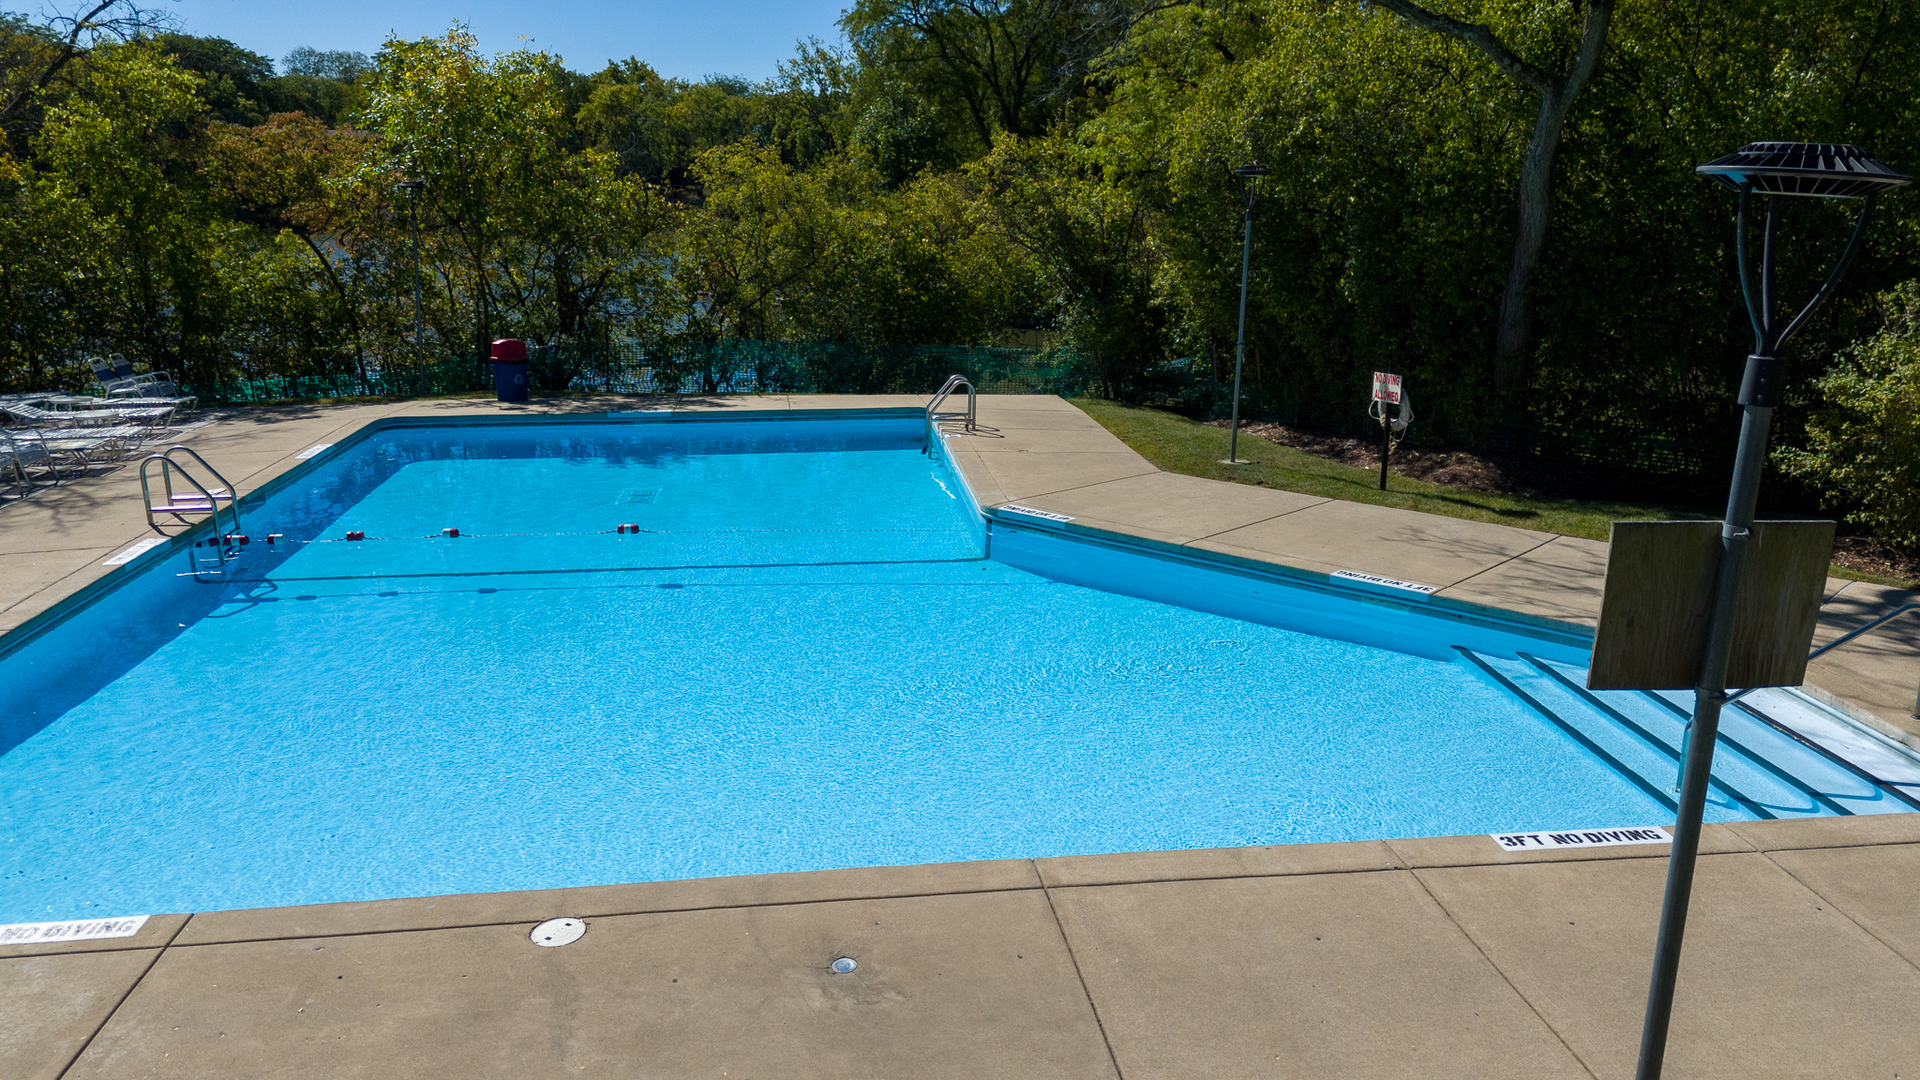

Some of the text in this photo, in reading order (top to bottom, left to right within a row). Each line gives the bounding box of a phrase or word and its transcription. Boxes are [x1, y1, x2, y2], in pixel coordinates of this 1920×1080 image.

[1375, 373, 1400, 386] NO DIVING
[1374, 389, 1398, 402] ALLOWED
[1336, 570, 1382, 582] DIVING
[1404, 584, 1434, 592] 3FT
[1499, 829, 1663, 847] 3FT NO DIVING
[0, 920, 136, 940] NO DIVING
